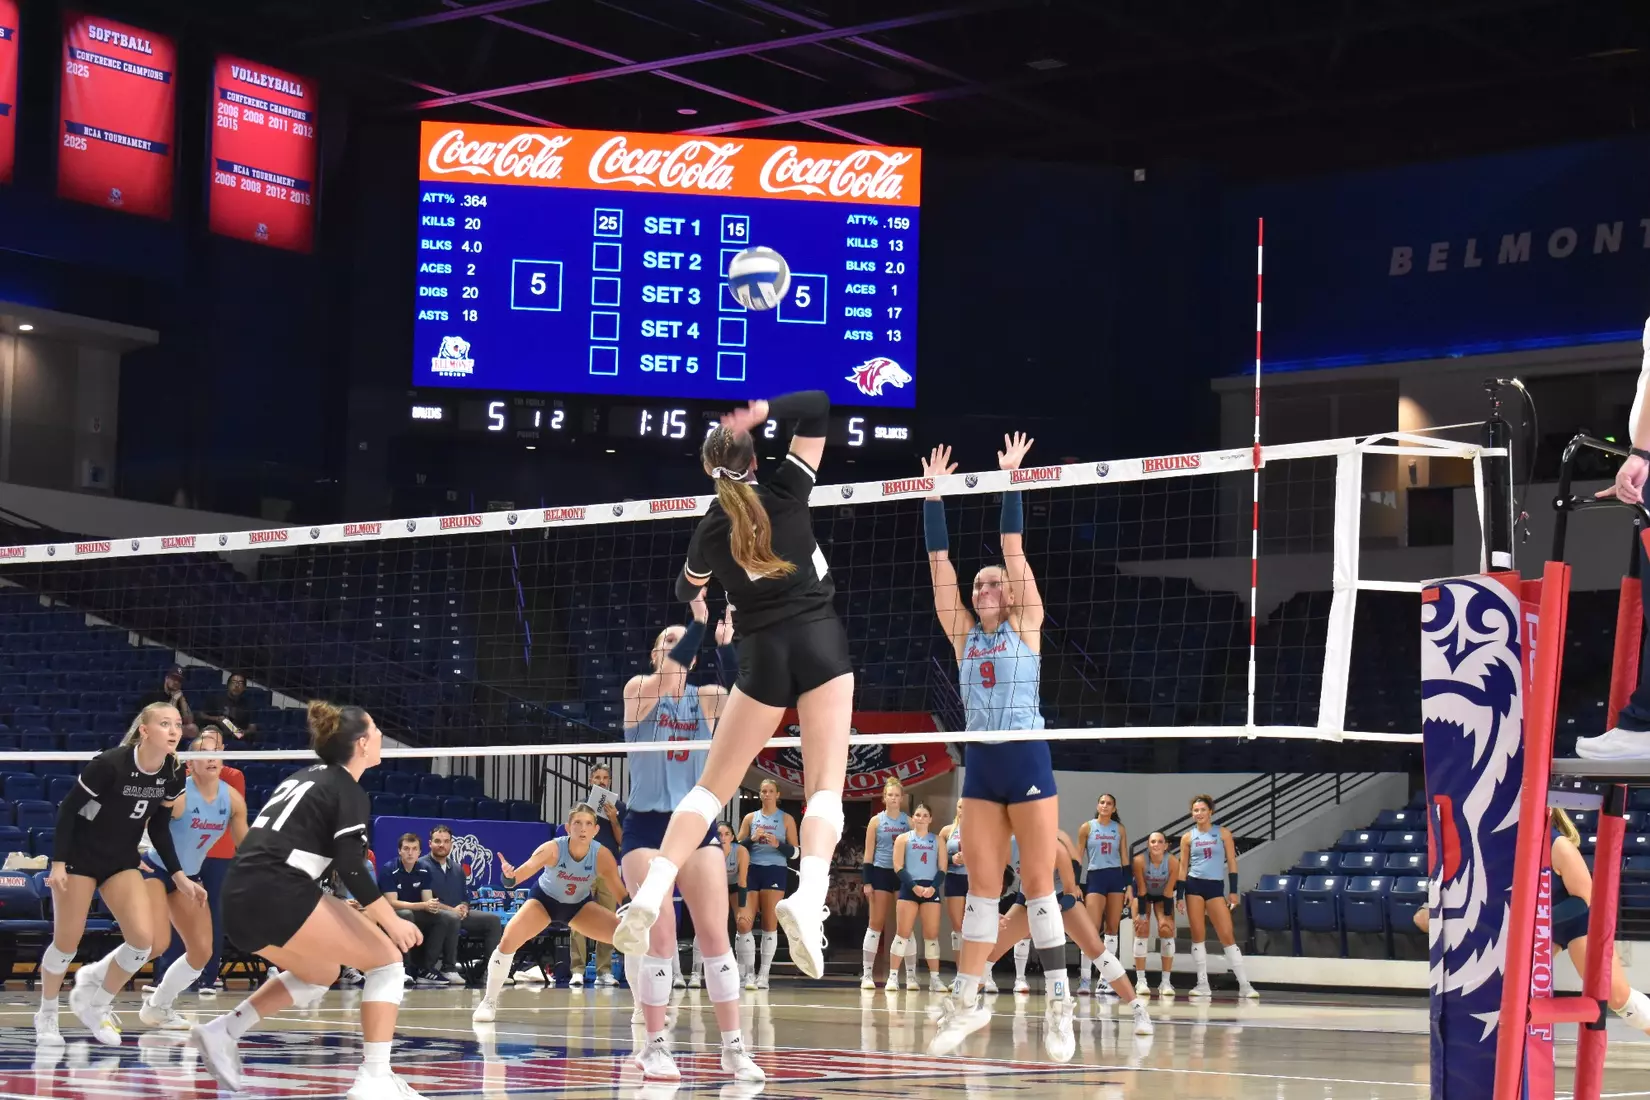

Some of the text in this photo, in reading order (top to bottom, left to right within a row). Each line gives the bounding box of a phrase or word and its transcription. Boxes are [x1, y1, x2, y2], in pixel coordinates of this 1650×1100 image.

[88, 24, 152, 55] SOFTBALL
[66, 61, 89, 78] 2025
[76, 50, 163, 80] CONFERENCE CHAMPIONS
[231, 65, 303, 98] VOLLEYBALL
[227, 91, 306, 121] CONFERENCE CHAMPIONS
[217, 102, 313, 138] 2006 2008 2011 2012
[217, 115, 238, 131] 2015
[63, 134, 87, 151] 2025
[83, 126, 151, 151] NCAA TOURNAMENT
[428, 129, 572, 179] Coca-Cola
[588, 136, 743, 190] Coca-Cola
[233, 164, 295, 187] NCAA TOURNAMENT
[759, 145, 912, 199] Coca-Cola
[215, 172, 310, 206] 2006 2008 2012 2015
[422, 193, 487, 207] ATT% .364
[422, 216, 481, 230] KILLS 20
[599, 216, 618, 230] 25
[644, 217, 700, 236] SET 1
[727, 223, 745, 238] 15
[846, 215, 910, 230] ATT% .159
[421, 240, 482, 253] BLKS 4.0
[846, 238, 904, 252] KILLS 13
[420, 264, 476, 276] ACES 2
[643, 251, 702, 271] SET 2
[845, 261, 905, 275] BLKS 2.0
[419, 287, 479, 299] DIGS 20
[530, 272, 547, 295] 5
[845, 284, 898, 297] ACES 1
[642, 286, 701, 305] SET 3
[795, 286, 811, 308] 5
[418, 310, 478, 321] ASTS 18
[844, 307, 902, 320] DIGS 17
[641, 320, 700, 339] SET 4
[844, 330, 902, 342] ASTS 13
[640, 354, 699, 374] SET 5
[488, 401, 505, 430] 5
[534, 410, 540, 427] 1
[551, 410, 564, 429] 2
[640, 409, 686, 439] 1:15
[764, 419, 777, 439] 2
[848, 417, 865, 446] 5
[76, 542, 111, 555] BRUINS
[161, 537, 195, 549] BELMONT
[250, 530, 288, 544] BRUINS
[344, 523, 381, 537] BELMONT
[440, 515, 481, 529] BRUINS
[544, 507, 586, 521] BELMONT
[650, 498, 696, 513] BRUINS
[882, 478, 934, 496] BRUINS
[1011, 467, 1062, 483] BELMONT
[1142, 454, 1200, 473] BRUINS
[980, 661, 996, 689] 9
[123, 785, 165, 798] SALUKIS
[129, 800, 149, 819] 9
[251, 779, 315, 832] 21
[191, 818, 225, 831] Belmont
[196, 834, 211, 850] 7
[1101, 842, 1112, 855] 21
[920, 852, 928, 864] 4
[557, 870, 590, 882] Belmont
[565, 884, 578, 896] 3
